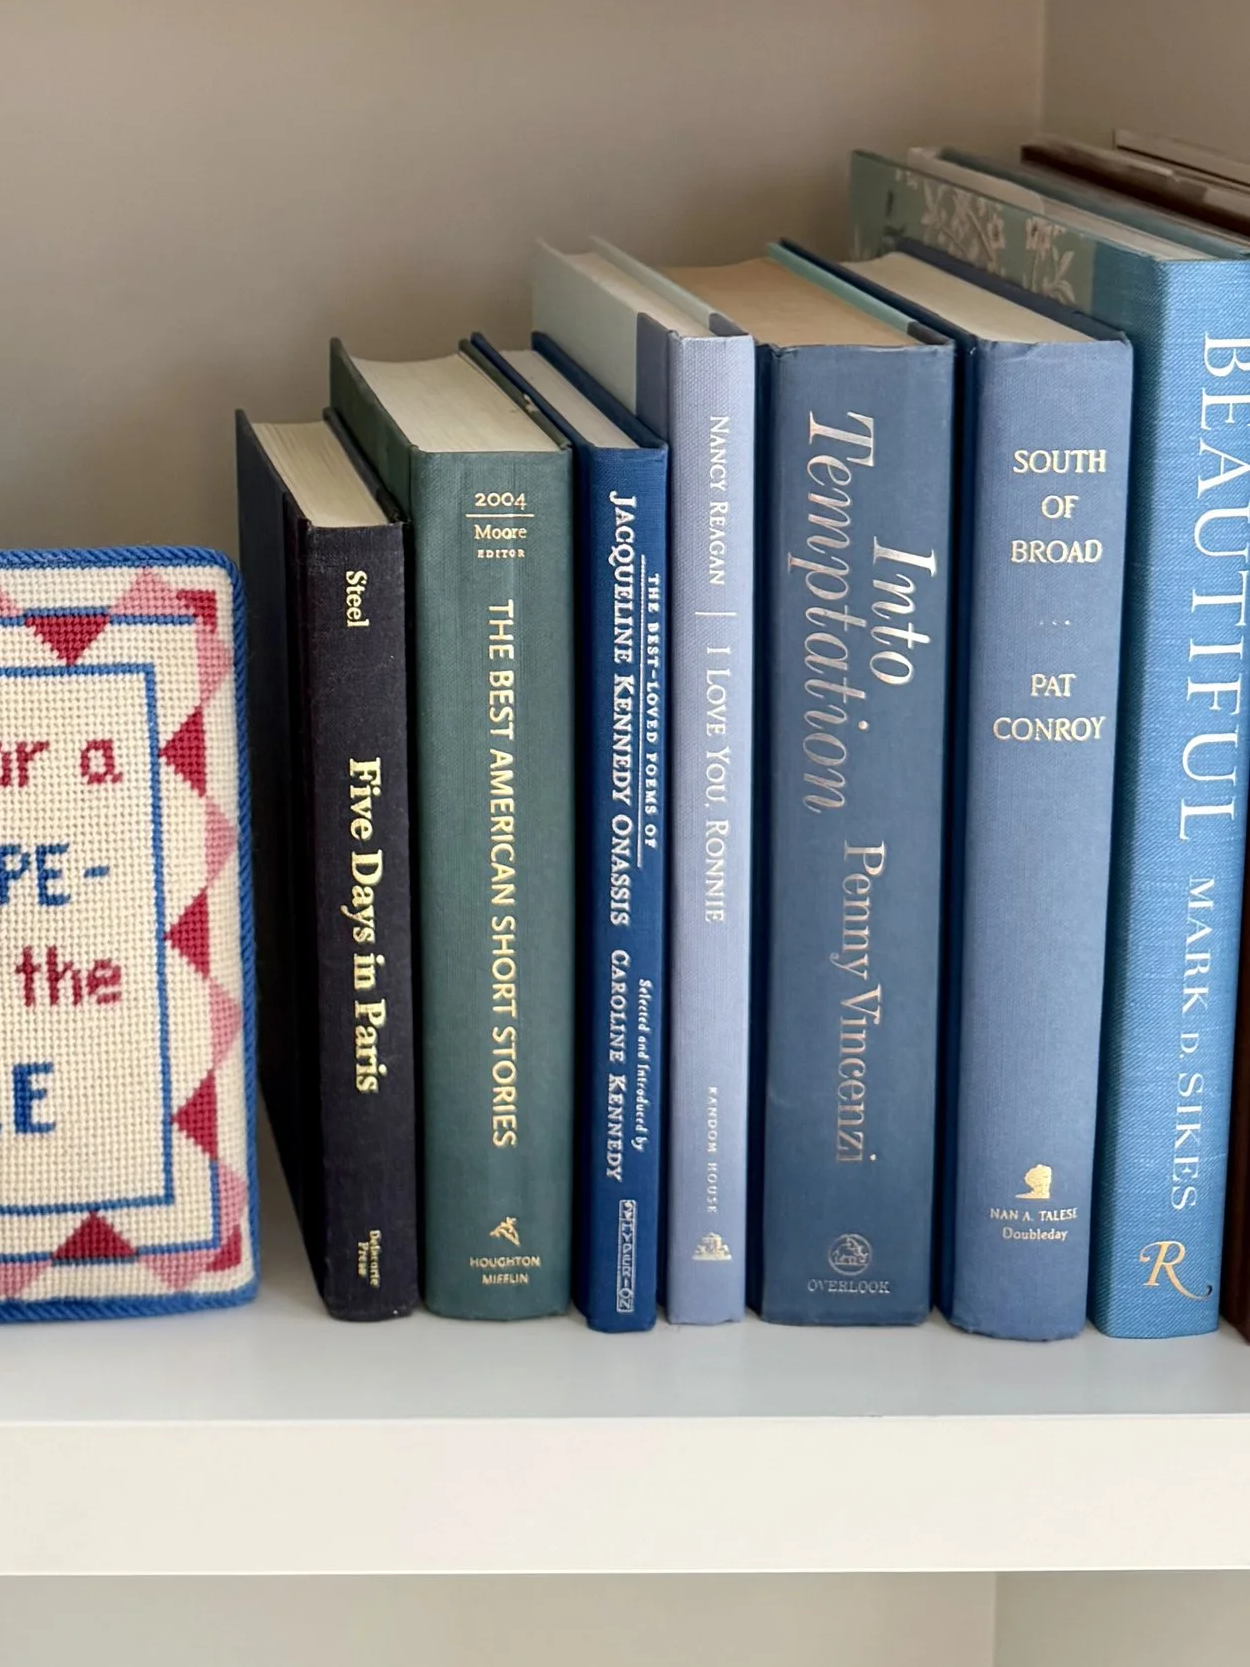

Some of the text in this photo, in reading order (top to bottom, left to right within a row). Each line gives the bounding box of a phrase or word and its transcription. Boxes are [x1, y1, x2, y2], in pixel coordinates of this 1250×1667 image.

[1012, 448, 1108, 475] SOUTH
[473, 492, 528, 511] 2004
[1040, 494, 1080, 521] OF
[473, 523, 528, 540] Moore
[476, 548, 526, 559] EDITOR
[1010, 539, 1104, 565] BROAD
[345, 569, 371, 629] Steel
[787, 409, 876, 816] Temptation
[868, 534, 938, 687] Into
[704, 415, 732, 924] NANCY REAGAN I LOVE YOU, RONNIE
[1030, 672, 1077, 699] PAT
[608, 490, 638, 929] JACQUELINE KENNEDY ONASSIS
[644, 573, 661, 850] THE BEST-LOVED POEMS OF
[992, 716, 1107, 743] CONROY
[79, 738, 124, 787] a
[1169, 330, 1250, 1212] BEAUTIFUL MARK D. SIKES
[488, 598, 519, 1149] THE BEST AMERICAN SHORT STORIES
[340, 756, 390, 1096] Five Days in Paris
[15, 944, 123, 1008] the
[829, 839, 887, 1164] Penny Vincenzi
[605, 948, 631, 1184] CAROLINE KENNEDY
[631, 978, 653, 1153] Selected and Introduced by
[707, 1086, 719, 1214] RANDOM HOUSE
[989, 1206, 1020, 1222] NAN
[1037, 1206, 1079, 1222] TALESE
[1002, 1225, 1069, 1242] Doubleday
[469, 1255, 542, 1269] HOUGHTON
[481, 1272, 530, 1286] MIFFLIN
[806, 1277, 892, 1296] OVERLOOK
